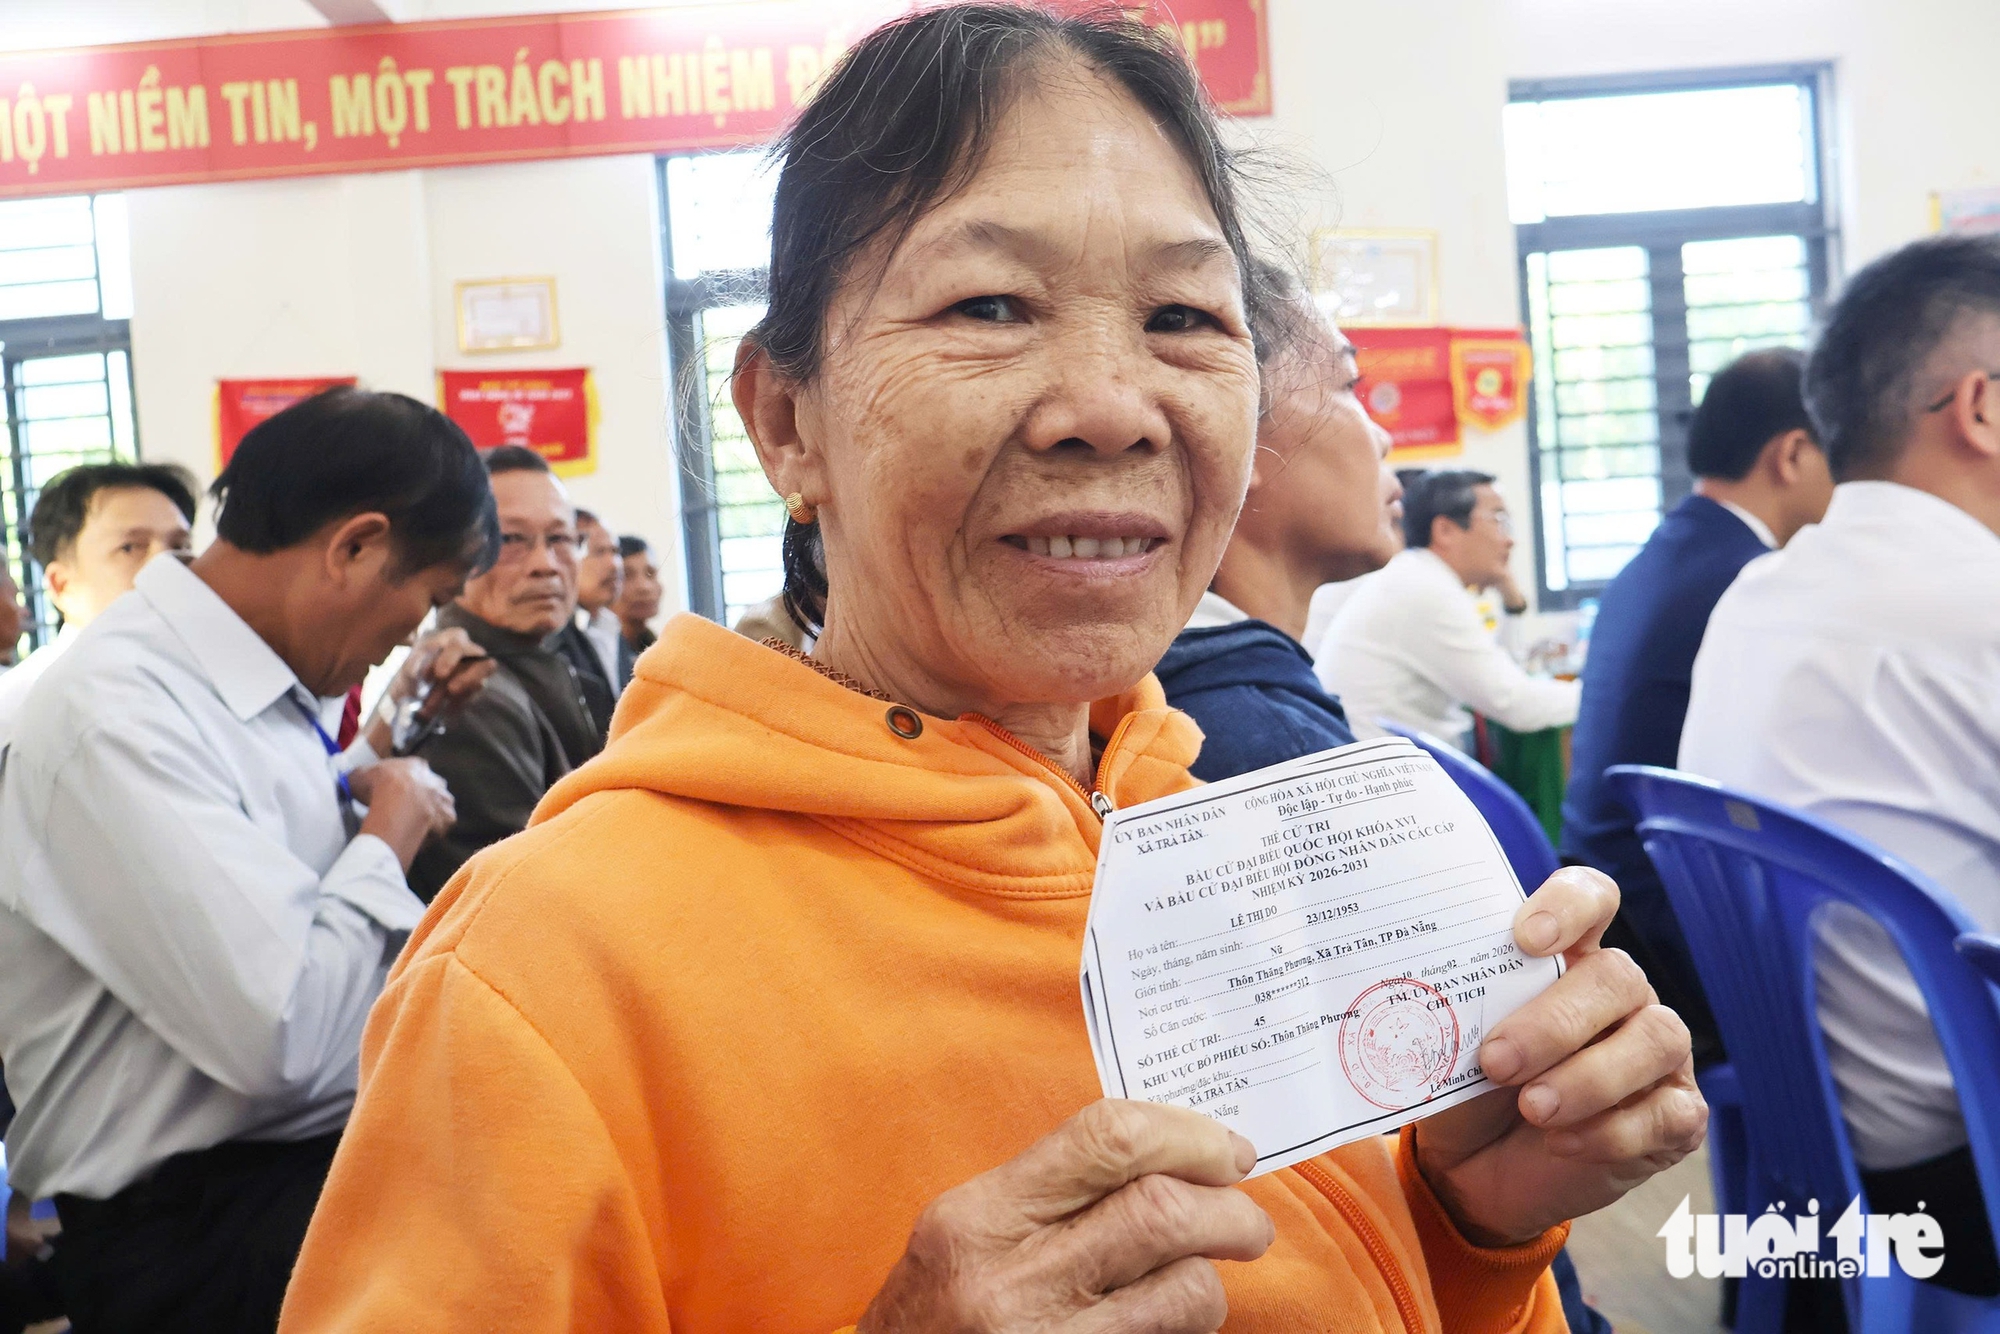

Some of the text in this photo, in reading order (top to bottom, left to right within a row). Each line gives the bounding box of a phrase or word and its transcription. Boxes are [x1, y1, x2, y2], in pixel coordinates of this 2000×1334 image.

[221, 78, 317, 151] TIN,
[330, 56, 433, 149] MỘT
[446, 46, 605, 130] TRÁCH
[619, 34, 774, 128] NHIỆM
[1245, 793, 1269, 811] CỘNG
[1270, 787, 1294, 803] HÒA
[1297, 782, 1314, 798] XÃ
[1316, 778, 1336, 793] HỘI
[1338, 771, 1360, 787] CHỦ
[1362, 766, 1394, 783] NGHĨA
[1396, 763, 1416, 777] VIỆT
[1278, 802, 1299, 816] Độc
[1301, 798, 1319, 814] lập
[1327, 792, 1343, 805] Tự
[1345, 787, 1358, 799] do
[1364, 781, 1391, 797] Hạnh
[1392, 777, 1414, 792] phúc
[1138, 821, 1163, 838] BAN
[1165, 813, 1200, 833] NHÂN
[1202, 806, 1226, 821] DÂN
[1306, 820, 1331, 835] TRI
[1137, 840, 1154, 856] XÃ
[1237, 856, 1257, 872] ĐẠI
[1356, 820, 1394, 839] KHÓA
[1395, 815, 1418, 830] XVI
[1144, 897, 1164, 913] VÀ
[1222, 876, 1244, 893] ĐẠI
[1339, 840, 1378, 859] NHÂN
[1380, 834, 1406, 849] DÂN
[1408, 826, 1434, 841] CÁC
[1288, 871, 1306, 887] KỲ
[1310, 858, 1369, 882] 2026-2031
[1128, 950, 1144, 962] Họ
[1146, 946, 1158, 956] và
[1230, 913, 1246, 928] LÊ
[1266, 905, 1278, 918] DO
[1131, 902, 1360, 981] Ngày, tháng, năm sinh: 23/12/1953
[1138, 1004, 1158, 1020] Nơi
[1160, 1001, 1174, 1012] cư
[1175, 995, 1192, 1008] trú:
[1228, 974, 1254, 989] Thôn
[1316, 947, 1332, 960] Xã
[1334, 943, 1352, 956] Trà
[1354, 938, 1378, 951] Tân,
[1378, 932, 1394, 944] TP
[1395, 926, 1410, 939] Đà
[1411, 920, 1438, 935] Nẵng
[1470, 952, 1490, 964] năm
[1492, 943, 1514, 958] 2026
[1134, 944, 1284, 1000] Giới tính: Nữ
[1386, 992, 1412, 1006] TM.
[1434, 976, 1460, 993] BAN
[1462, 966, 1498, 986] NHÂN
[1499, 958, 1526, 974] DÂN
[1456, 986, 1486, 1004] TỊCH
[1143, 1024, 1158, 1040] Số
[1160, 1020, 1180, 1034] Căn
[1200, 1033, 1222, 1048] TRI:
[1254, 1015, 1266, 1028] 45
[1142, 1071, 1170, 1090] KHU
[1171, 1062, 1195, 1078] VỰC
[1271, 1030, 1295, 1045] Thôn
[1188, 1076, 1249, 1109] XÃ TRÀ TÂN
[1444, 1072, 1466, 1088] Minh
[1214, 1103, 1240, 1120] Nẵng
